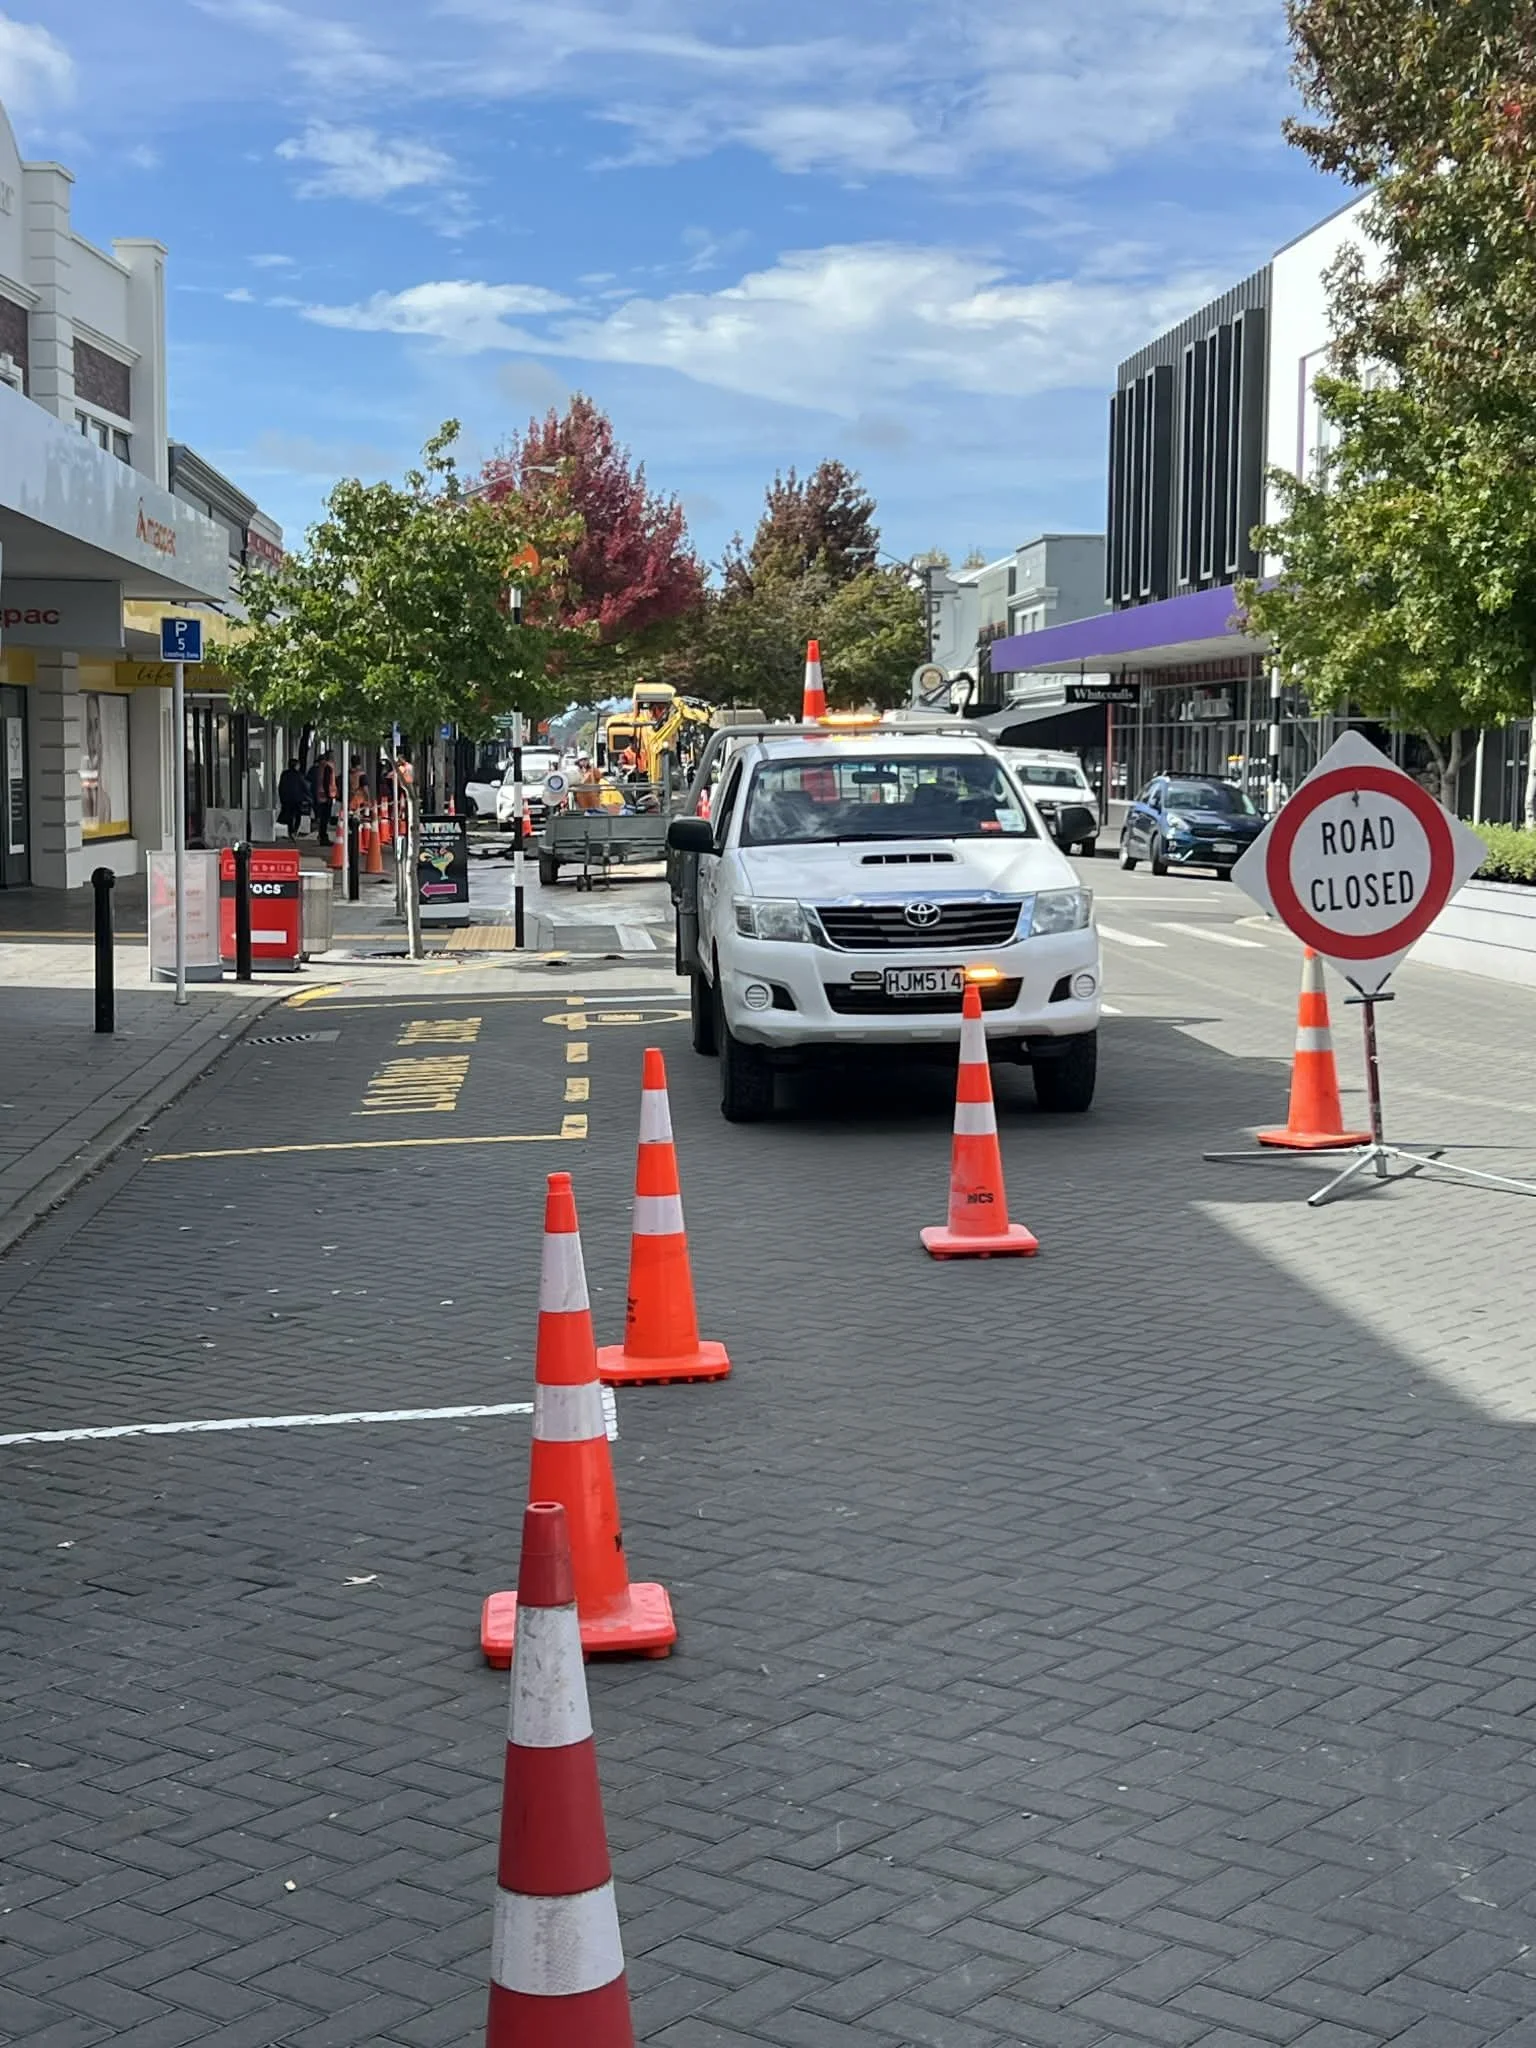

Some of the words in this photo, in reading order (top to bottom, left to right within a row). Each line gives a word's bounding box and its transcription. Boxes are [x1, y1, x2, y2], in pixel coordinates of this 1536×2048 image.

[0, 608, 60, 629] pac
[175, 621, 188, 637] P
[177, 638, 186, 651] 5
[418, 822, 463, 834] ANTINA
[1321, 816, 1396, 856] ROAD
[1310, 870, 1415, 913] CLOSED
[887, 971, 962, 993] HJM514
